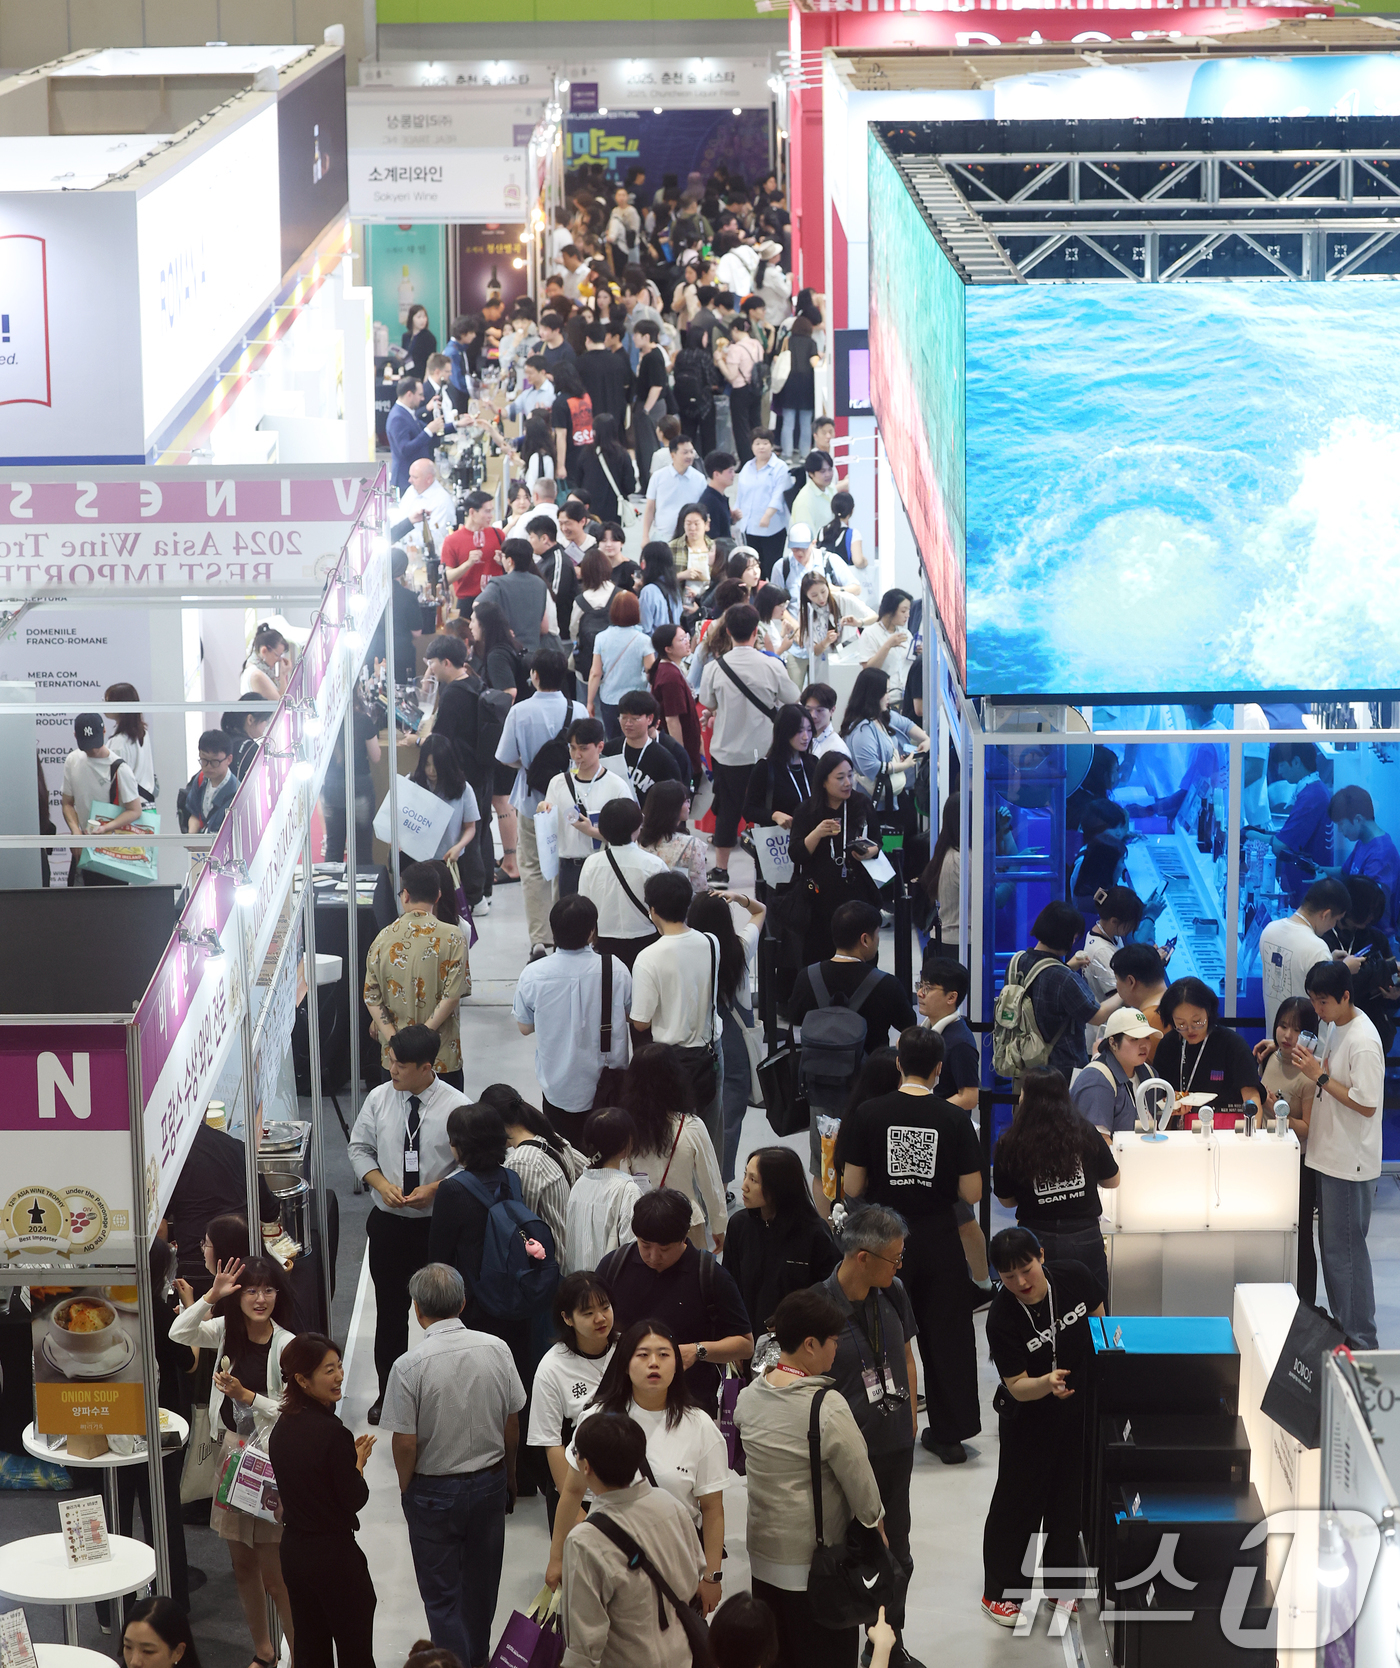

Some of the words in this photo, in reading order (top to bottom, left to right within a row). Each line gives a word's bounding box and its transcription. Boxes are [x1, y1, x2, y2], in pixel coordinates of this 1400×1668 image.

[368, 166, 443, 183] 소계리와인
[374, 191, 411, 203] Sokyeri
[413, 191, 438, 201] Wine
[26, 628, 77, 636] DOMENIILE
[26, 637, 108, 645] FRANCO-ROMANE
[402, 806, 432, 828] GOLDEN
[402, 819, 421, 834] BLUE
[161, 1080, 184, 1169] 프랑스
[213, 975, 227, 1048] 전문
[36, 1051, 91, 1119] N
[917, 1180, 933, 1188] ME
[65, 1187, 84, 1195] under
[84, 1190, 95, 1200] the
[17, 1189, 30, 1199] ASIA
[46, 1190, 65, 1209] TROPHY
[1038, 1194, 1067, 1205] SCAN
[1069, 1191, 1085, 1199] ME
[94, 1197, 109, 1229] Patronage
[28, 1225, 47, 1233] 2024
[101, 1229, 107, 1238] of
[32, 1235, 58, 1243] Importer
[94, 1235, 104, 1246] the
[83, 1243, 95, 1253] OIV
[1026, 1301, 1087, 1353] BOOS
[61, 1391, 91, 1403] ONION
[94, 1390, 119, 1403] SOUP
[72, 1406, 110, 1417] 양파수프
